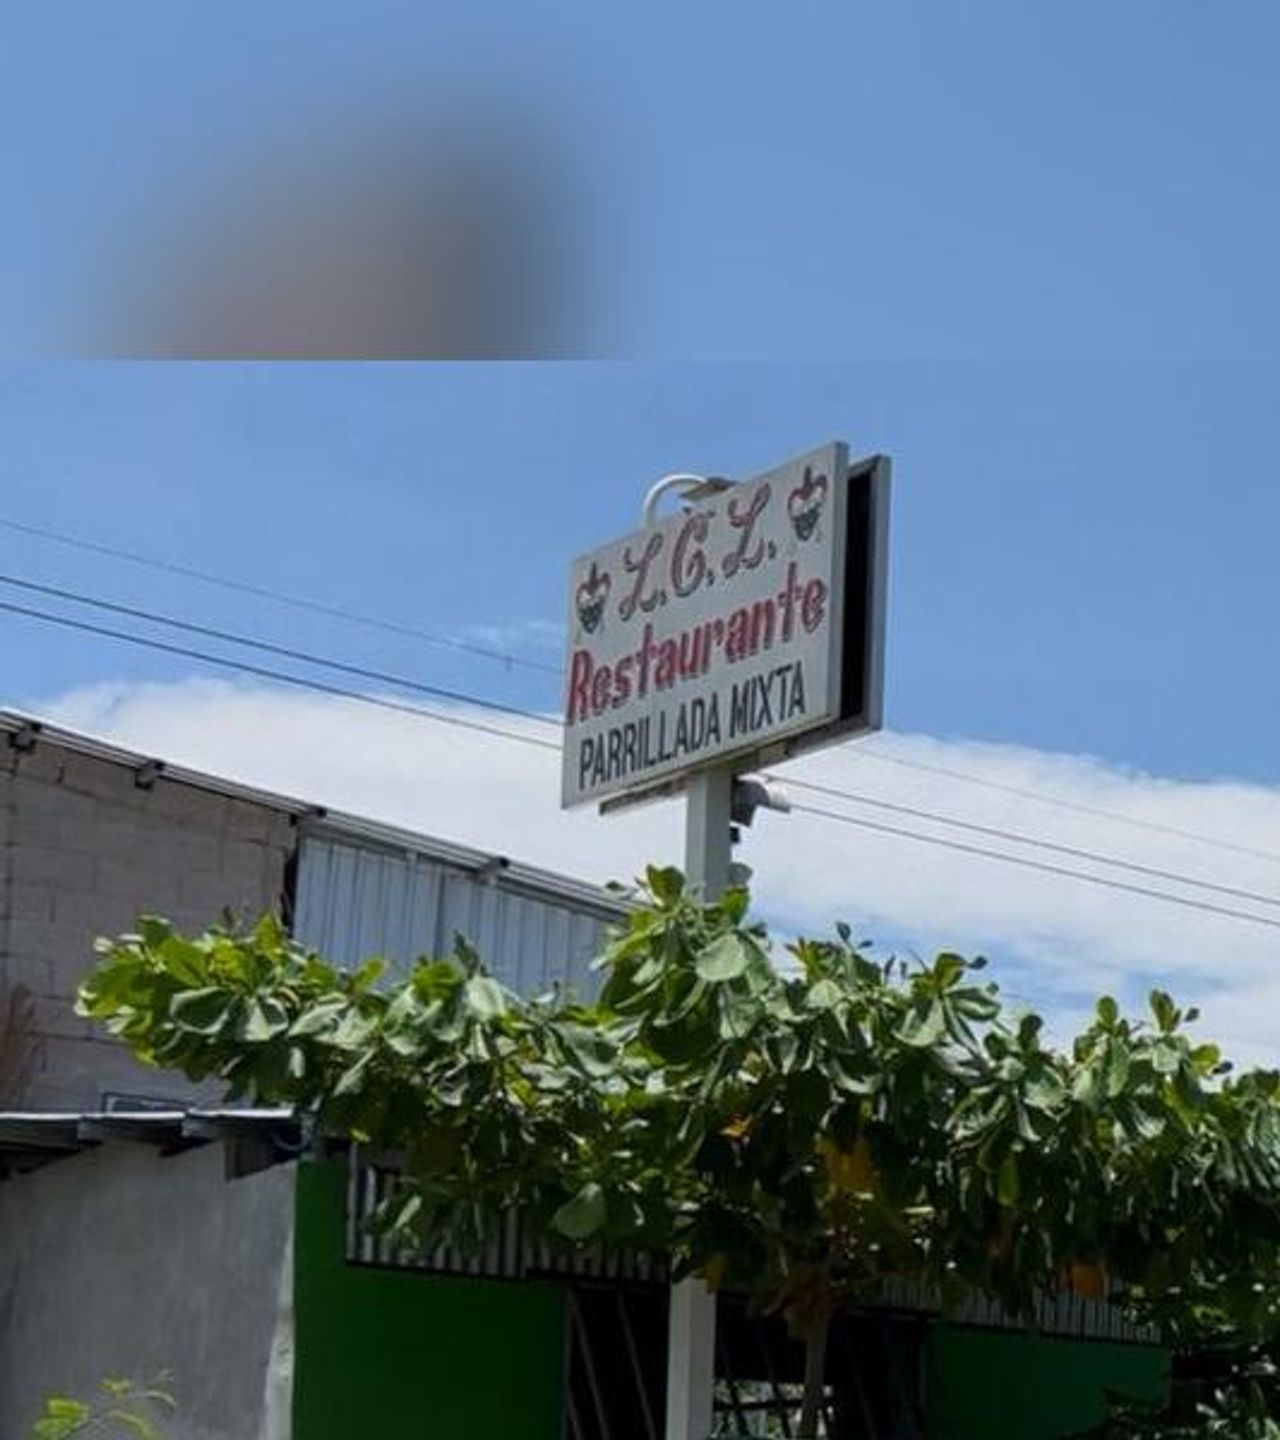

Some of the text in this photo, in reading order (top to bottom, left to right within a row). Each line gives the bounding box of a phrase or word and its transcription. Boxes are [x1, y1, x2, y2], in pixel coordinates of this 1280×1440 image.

[567, 560, 826, 724] Restaurante
[577, 660, 805, 790] PARRILLADA MIXTA
